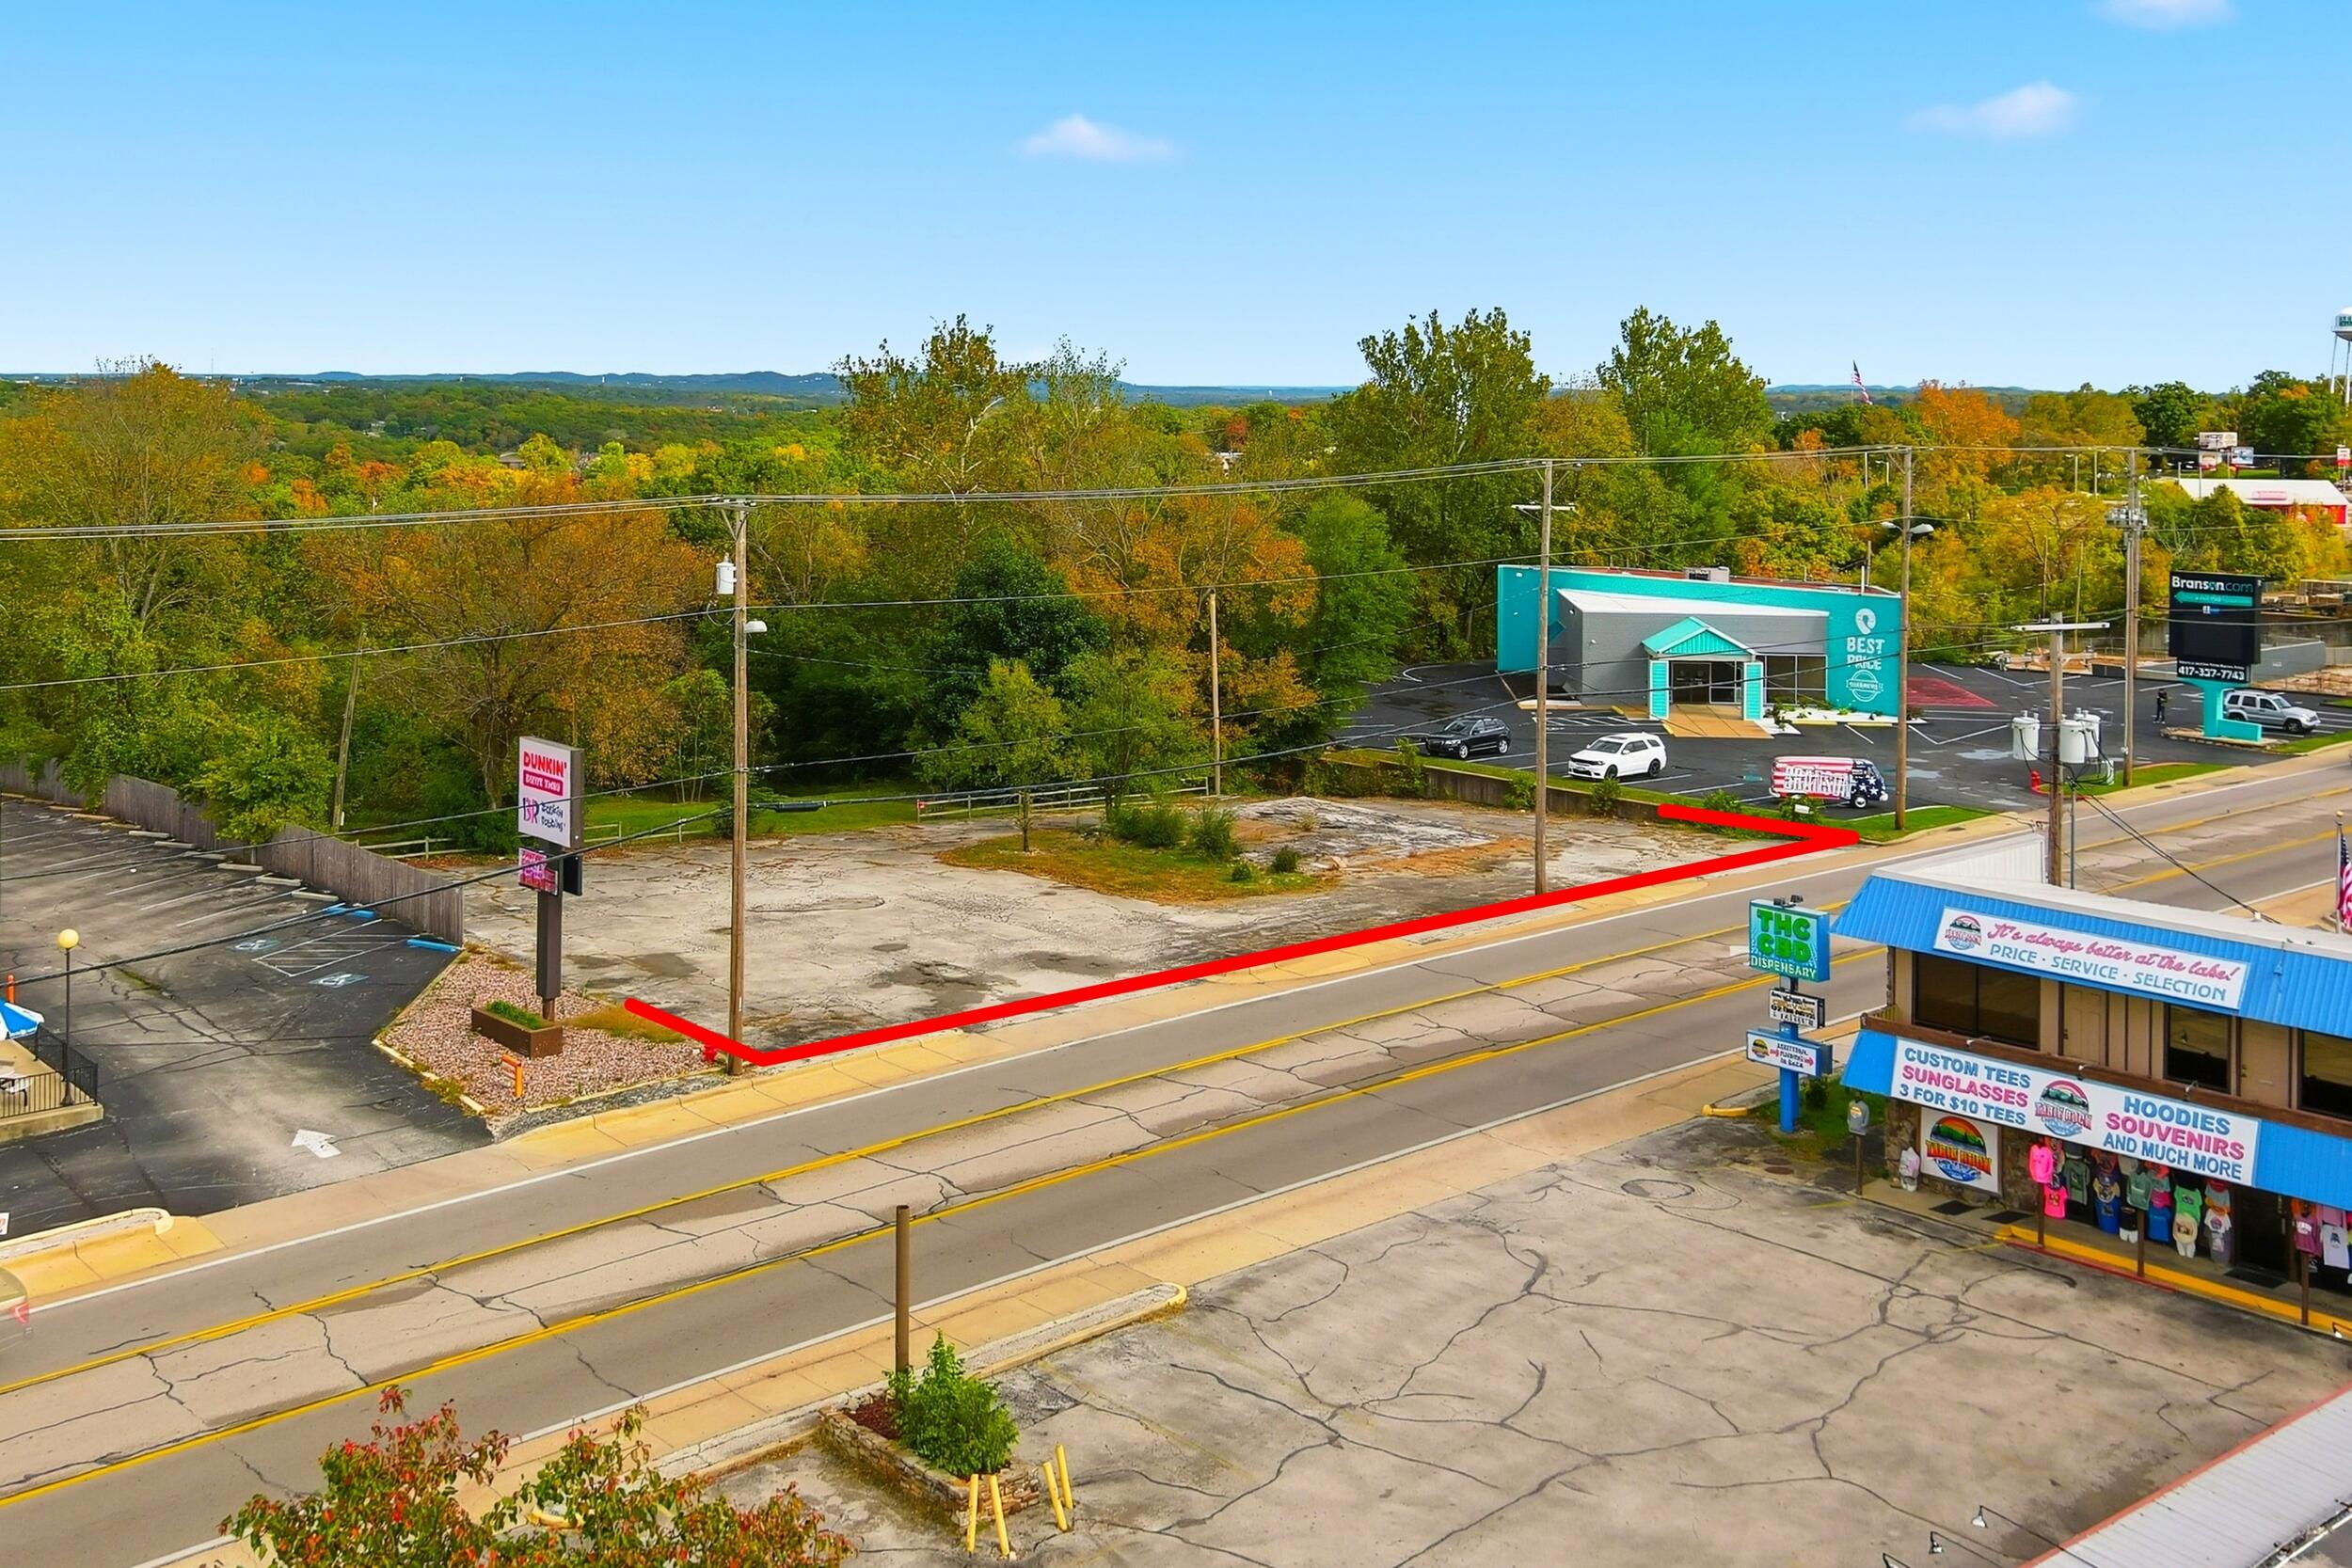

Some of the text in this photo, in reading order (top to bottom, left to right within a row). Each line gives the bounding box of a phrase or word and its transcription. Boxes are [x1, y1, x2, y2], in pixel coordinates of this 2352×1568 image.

[1847, 637, 1884, 655] BEST
[1847, 654, 1883, 671] PRICE
[523, 751, 567, 778] DUNKIN'
[1756, 909, 1811, 941] THC
[1757, 935, 1812, 963] CBD
[1987, 923, 2023, 941] It's
[2025, 932, 2084, 953] always
[2086, 942, 2133, 961] better
[2135, 953, 2157, 966] at
[2157, 954, 2186, 972] the
[2188, 960, 2241, 981] lake!
[1990, 943, 2227, 1002] PRICE SERVICE SELECTION
[1902, 1065, 2029, 1108] SUNGLASSES
[1904, 1047, 2031, 1088] CUSTOM TEES
[1899, 1084, 1909, 1097] 3
[1914, 1086, 1946, 1107] FOR
[1949, 1096, 1979, 1115] $10
[1983, 1103, 2026, 1126] TEES
[2123, 1096, 2231, 1135] HOODIES
[2103, 1132, 2242, 1180] AND MUCH MORE
[2106, 1112, 2245, 1161] SOUVENIRS
